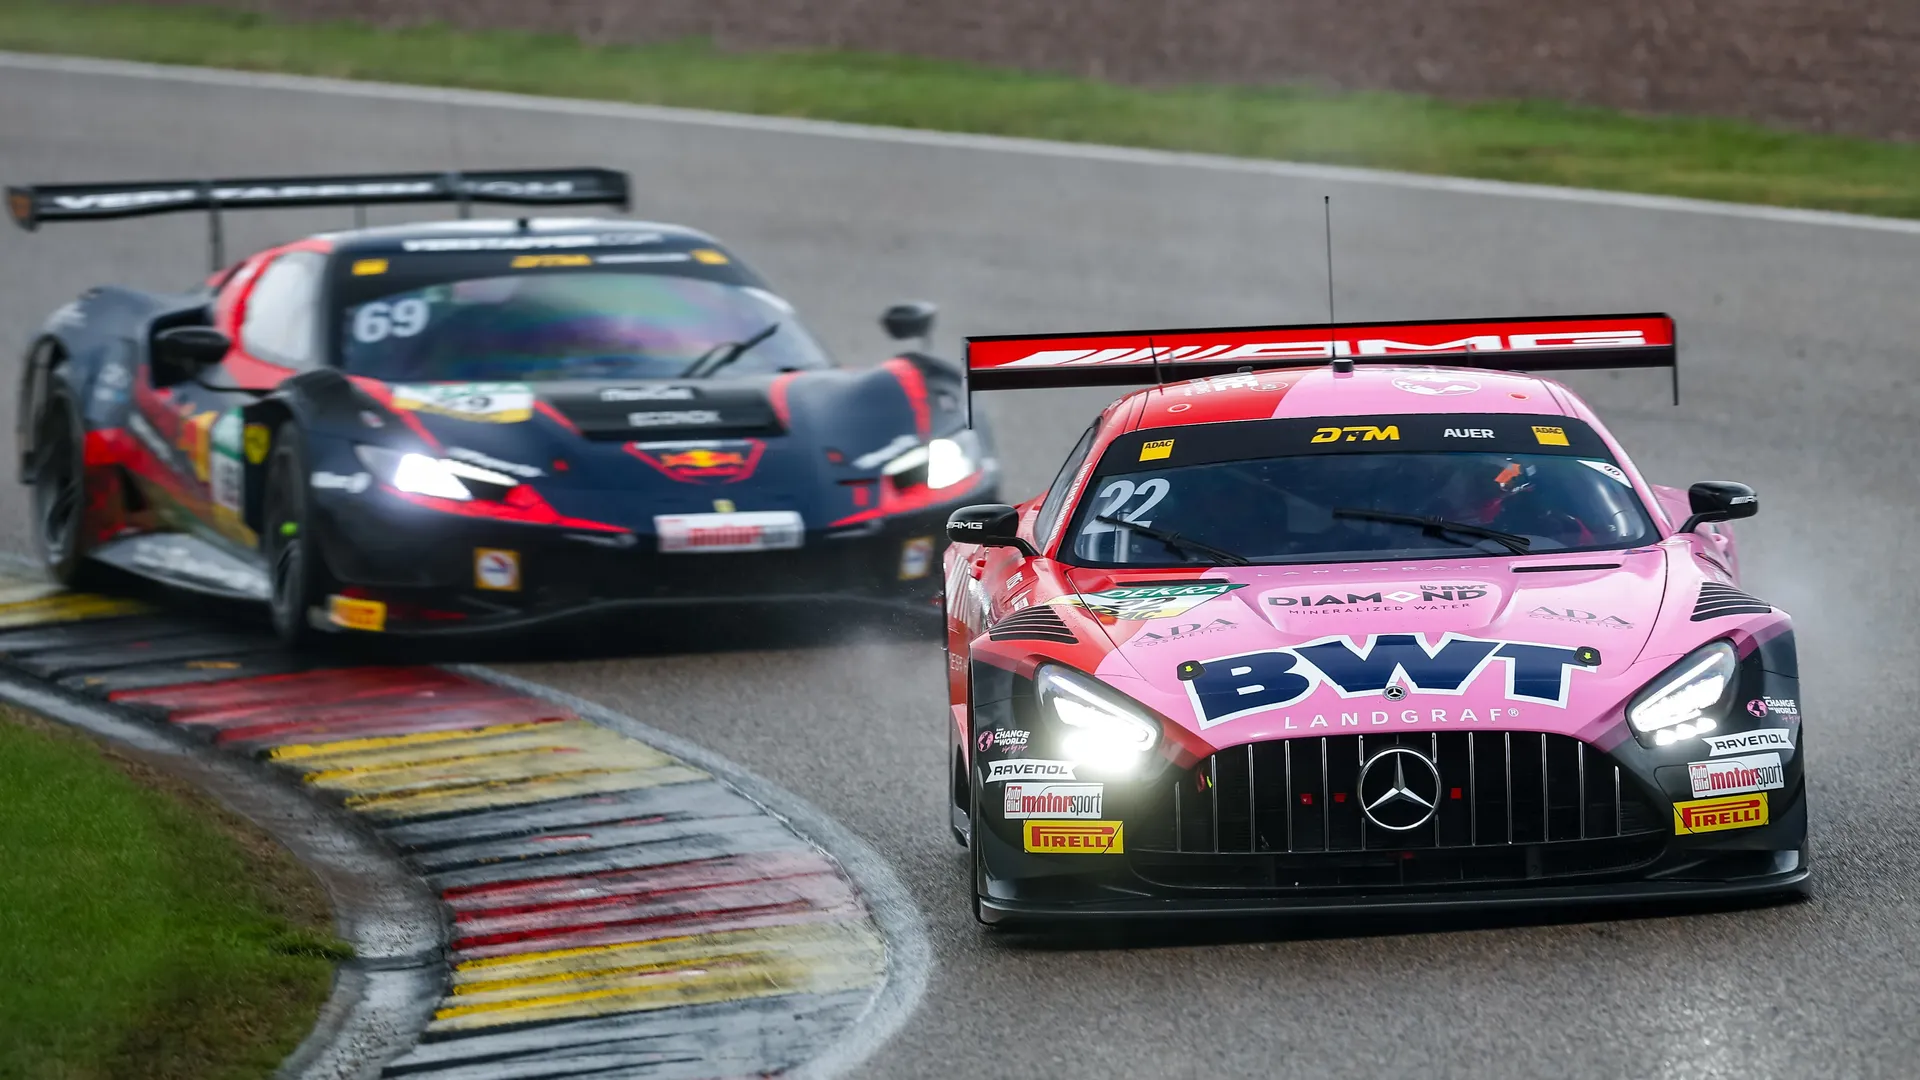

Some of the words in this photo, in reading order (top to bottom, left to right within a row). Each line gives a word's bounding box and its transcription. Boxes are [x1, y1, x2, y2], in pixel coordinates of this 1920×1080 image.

[353, 298, 429, 344] 69
[1311, 425, 1400, 443] DTM
[1443, 428, 1495, 439] AUER
[1536, 427, 1563, 436] ADAC
[1144, 440, 1173, 450] ADAC
[1082, 478, 1170, 536] 22
[950, 521, 983, 530] AMG
[1098, 586, 1230, 598] DEKRA
[1102, 597, 1177, 611] 22
[1289, 606, 1404, 615] MINERALIZED
[1414, 603, 1471, 611] WATER
[1527, 606, 1635, 626] ADA
[1529, 614, 1634, 630] COSMETICS
[1133, 618, 1237, 644] ADA
[1133, 625, 1238, 648] COSMETICS
[1192, 633, 1592, 726] BWT
[1765, 699, 1796, 707] CHANGE
[1774, 707, 1798, 715] WORLD
[995, 730, 1031, 739] CHANGE
[999, 738, 1028, 746] WORLD
[1715, 734, 1787, 751] RAVENOL
[993, 764, 1069, 776] RAVENOL
[1710, 764, 1783, 790] motorsport
[1022, 792, 1102, 815] motorsport
[1682, 800, 1761, 829] PIRELLI
[1032, 826, 1115, 848] PIRELLI
